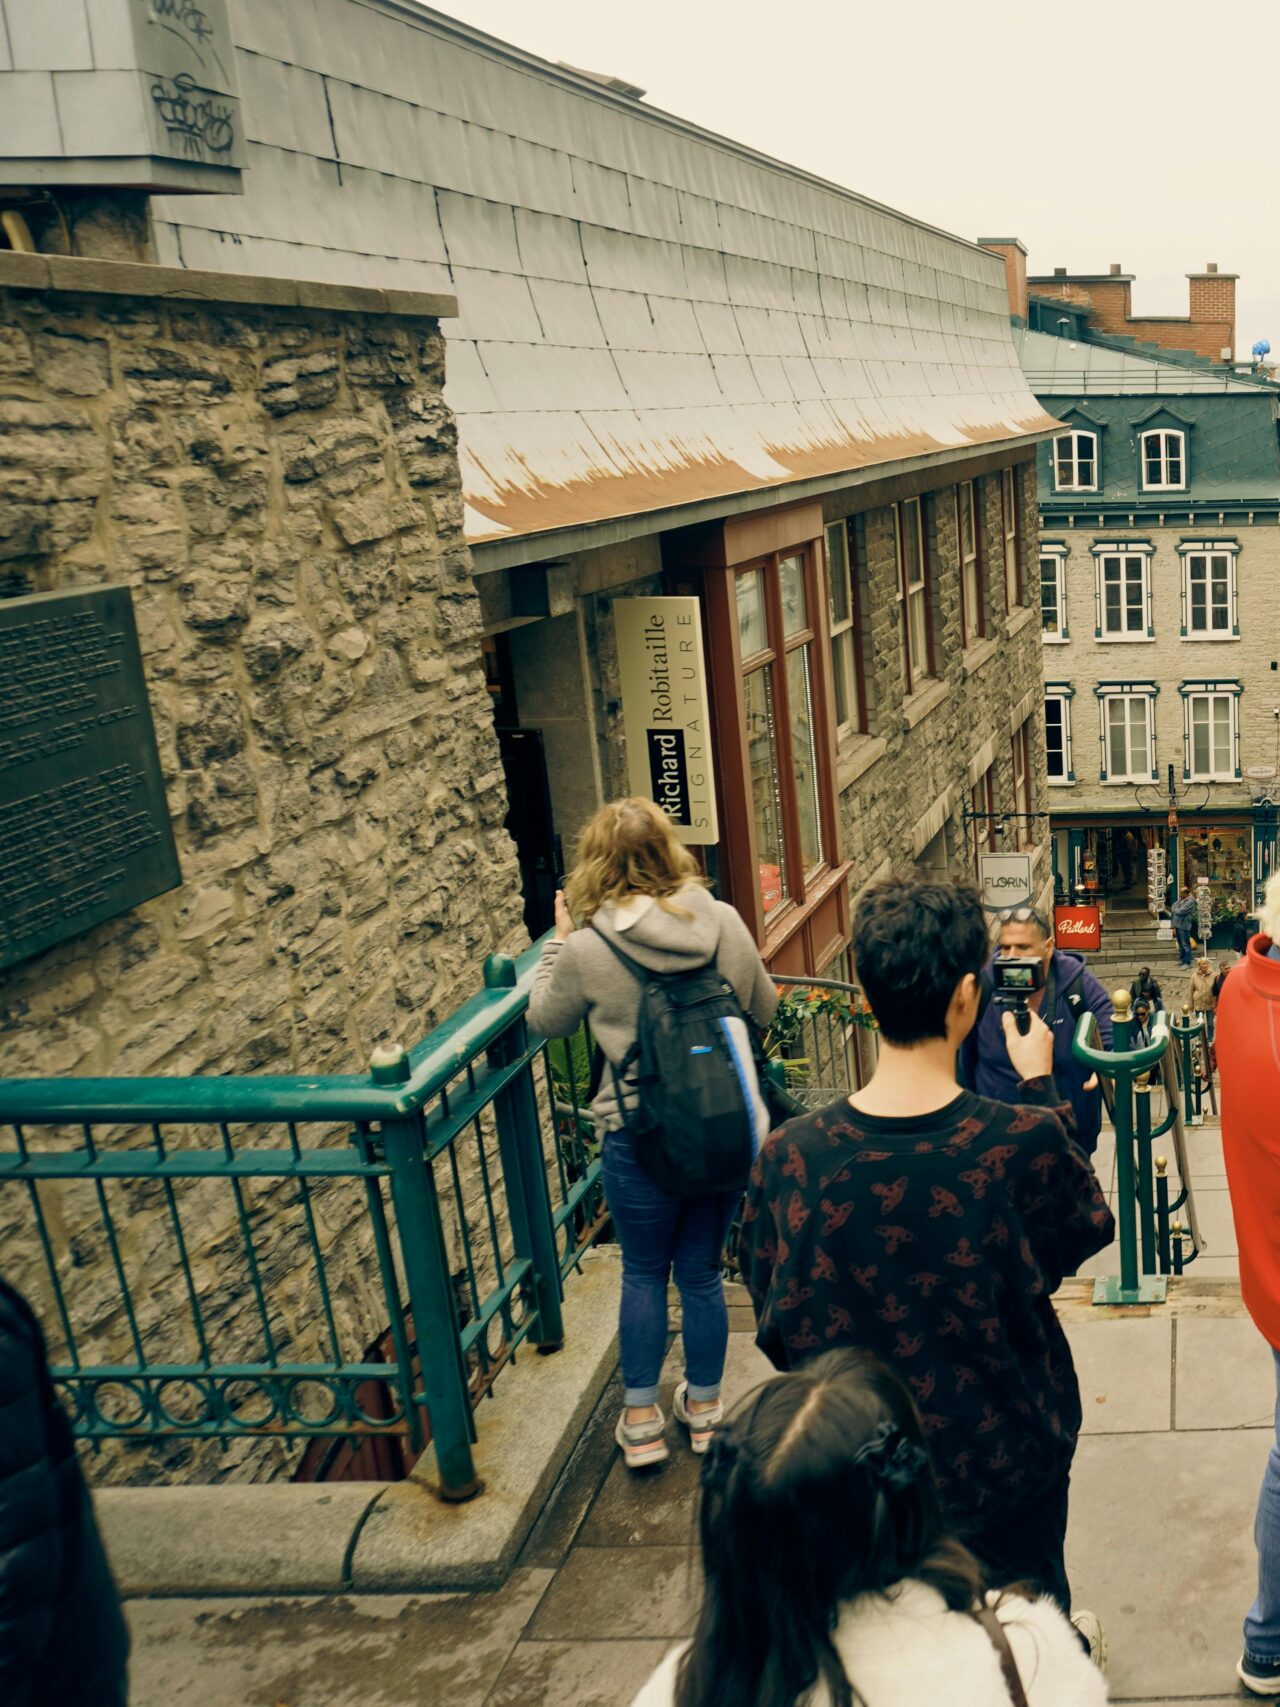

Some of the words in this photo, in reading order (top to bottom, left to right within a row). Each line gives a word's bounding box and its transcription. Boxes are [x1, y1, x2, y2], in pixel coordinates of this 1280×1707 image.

[645, 614, 673, 723] Robitaille
[677, 614, 709, 828] SIGNATURE
[654, 734, 683, 818] Richard
[984, 877, 1028, 888] FLORIN
